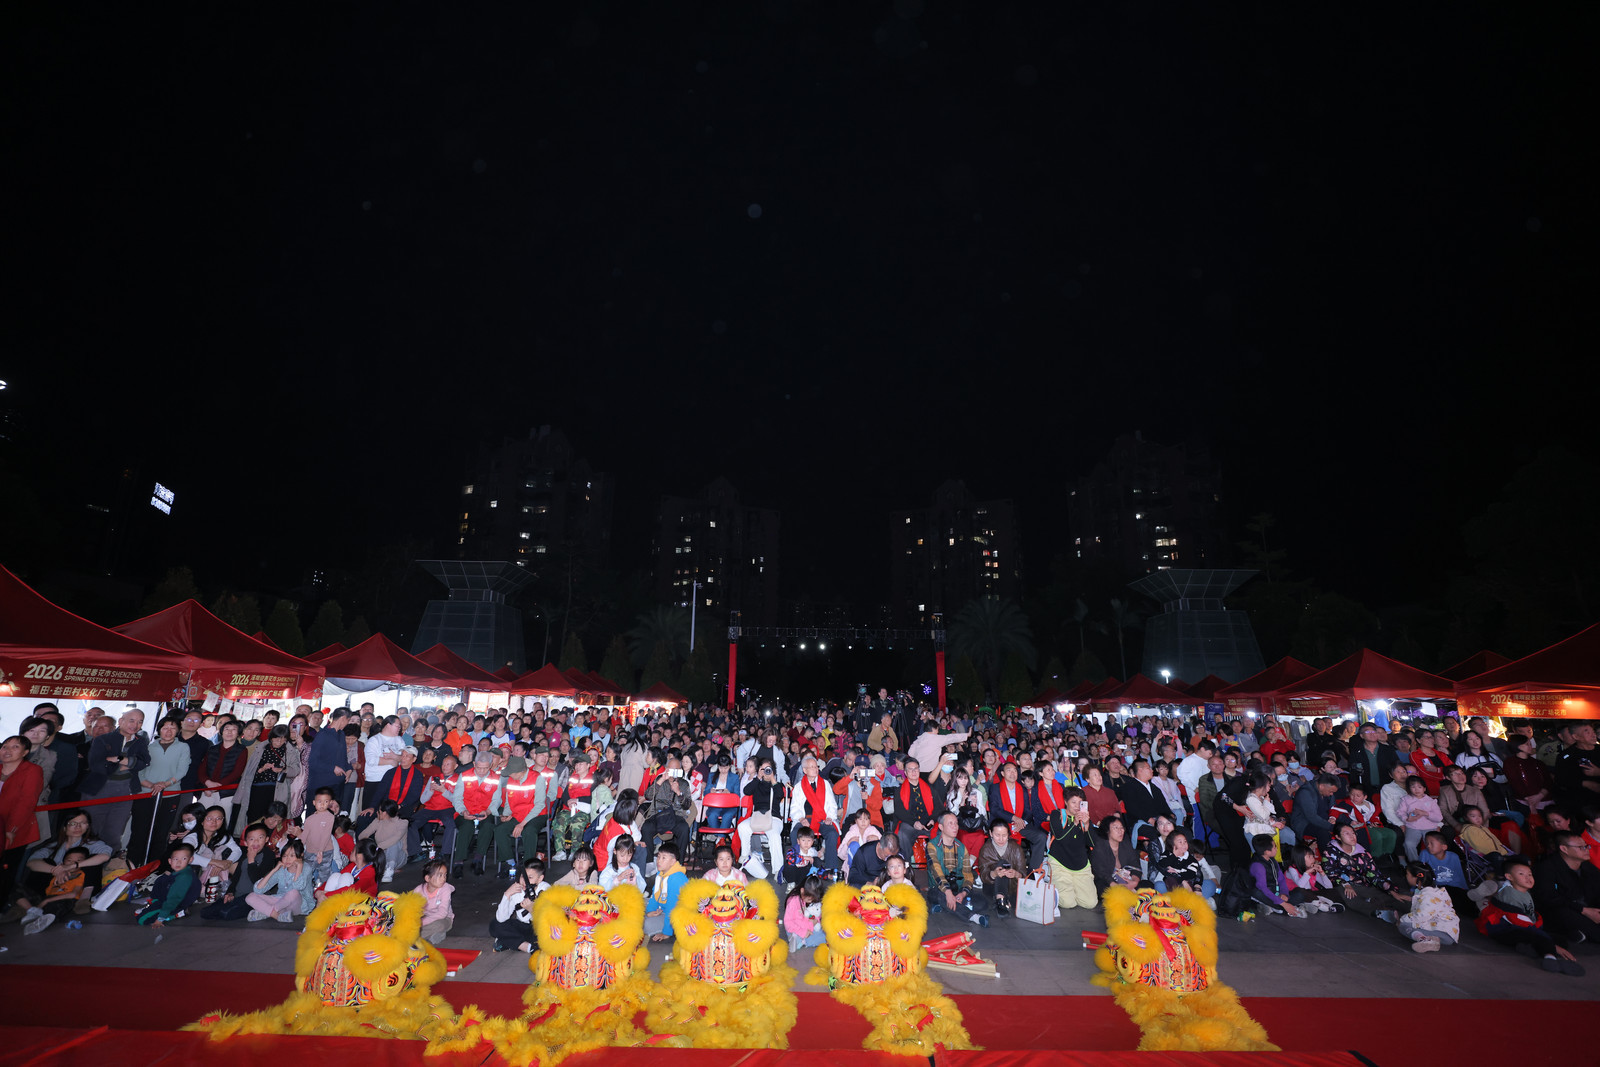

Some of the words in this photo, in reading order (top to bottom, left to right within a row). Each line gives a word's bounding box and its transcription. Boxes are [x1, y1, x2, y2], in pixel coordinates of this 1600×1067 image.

[24, 663, 64, 680] 2026
[111, 670, 142, 679] SHENZHEN
[230, 674, 250, 685] 2026
[1490, 694, 1512, 704] 2026
